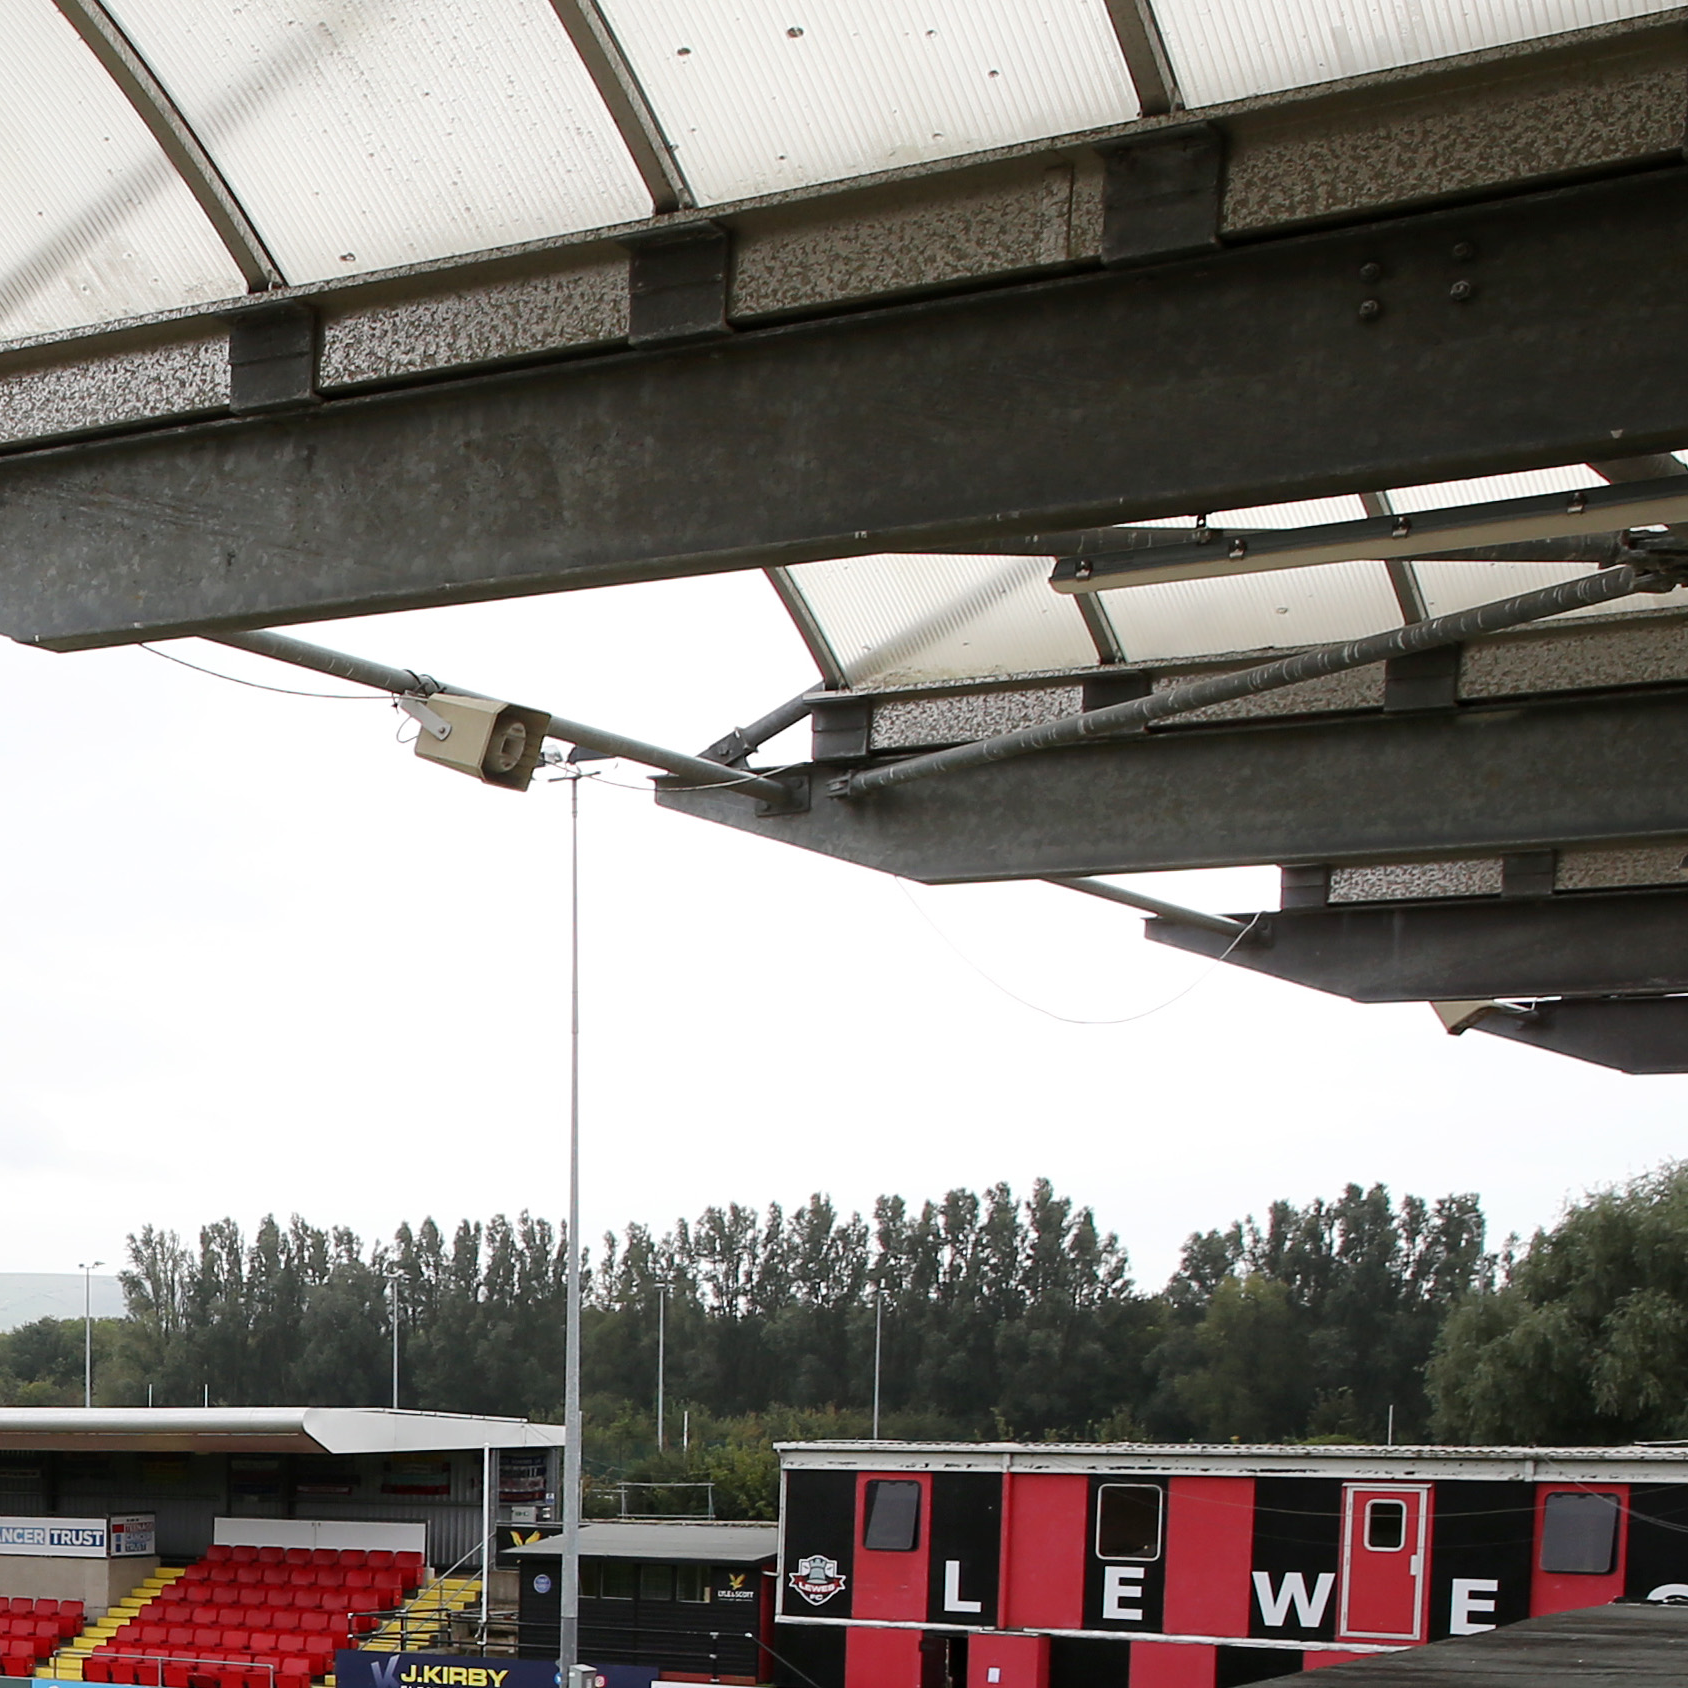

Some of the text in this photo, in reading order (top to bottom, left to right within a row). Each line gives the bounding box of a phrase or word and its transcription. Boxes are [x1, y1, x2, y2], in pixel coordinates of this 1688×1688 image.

[50, 1529, 104, 1546] TRUST
[797, 1581, 835, 1593] LEWES
[809, 1593, 823, 1601] FC
[400, 1664, 509, 1688] J.KIRBY
